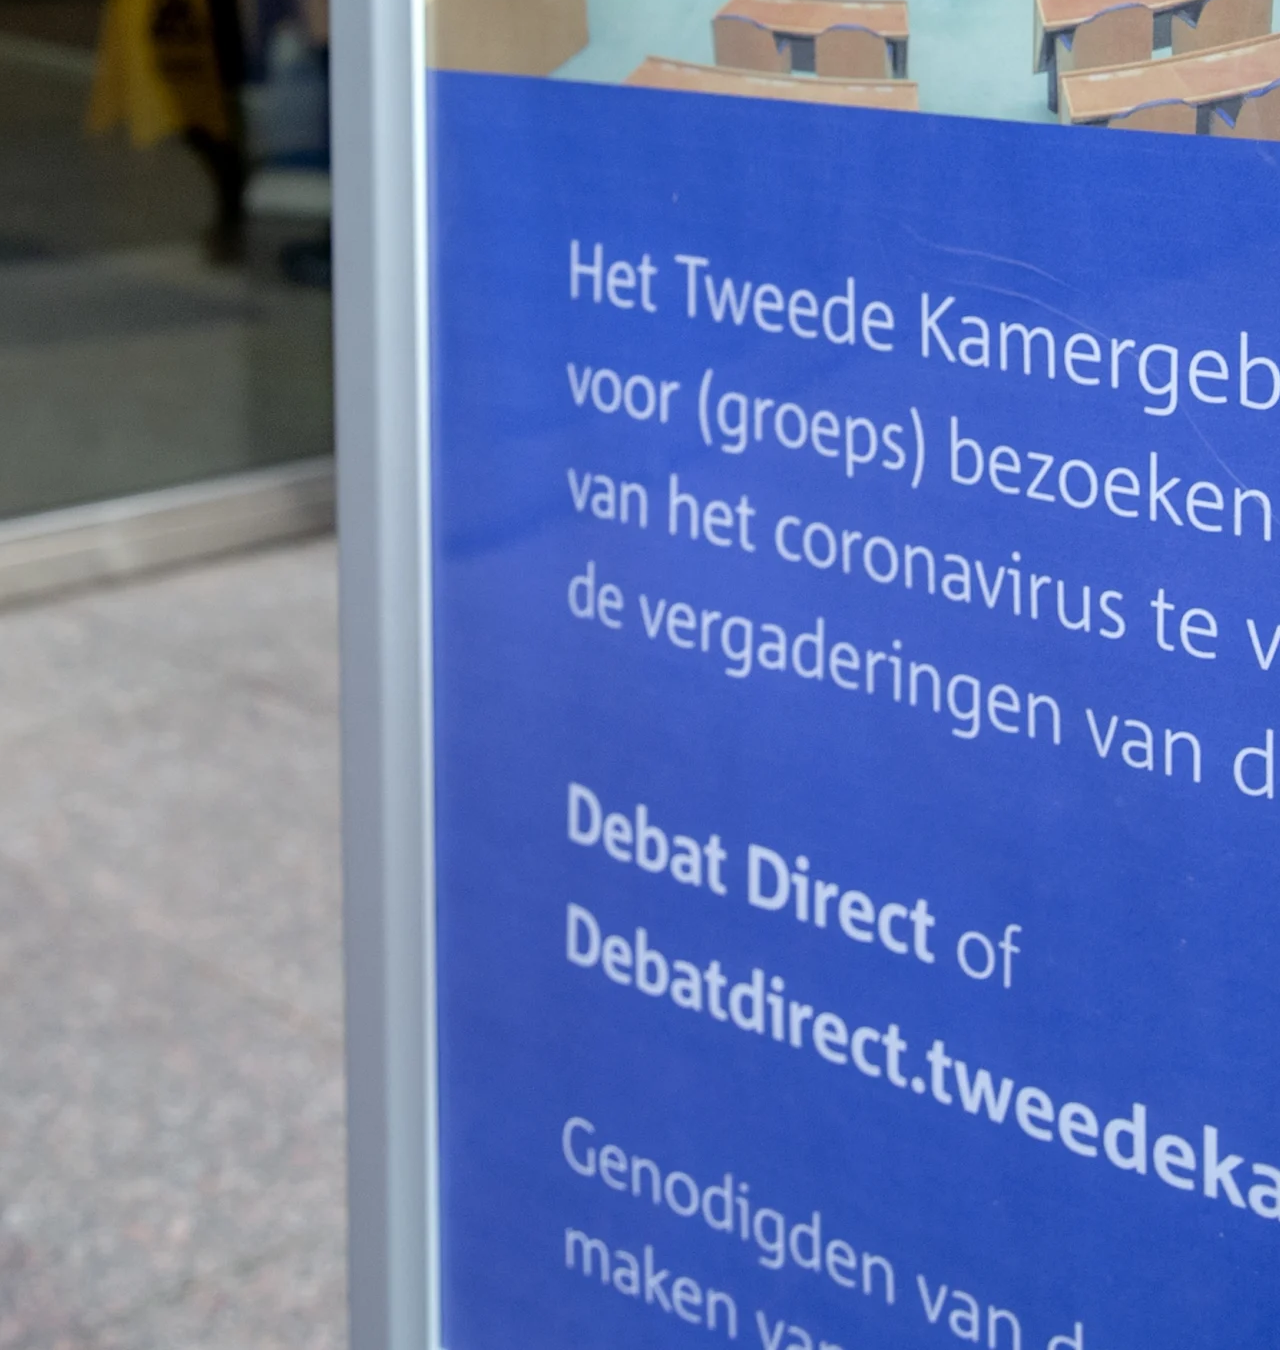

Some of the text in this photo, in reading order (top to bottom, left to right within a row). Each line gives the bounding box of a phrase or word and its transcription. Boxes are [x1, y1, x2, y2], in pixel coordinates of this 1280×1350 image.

[569, 239, 658, 313] Het
[674, 253, 895, 352] Tweede
[567, 363, 681, 424] voor
[698, 368, 925, 489] (groeps)
[950, 415, 1273, 542] bezoeken
[567, 468, 648, 528] van
[668, 473, 756, 552] het
[774, 515, 1126, 640] coronavirus
[1150, 588, 1219, 660] te
[568, 561, 624, 629] de
[639, 595, 1061, 745] vergaderingen
[1085, 708, 1202, 783] van
[567, 782, 1022, 989] Debat Direct of
[562, 1116, 1022, 1350] Genodigden van
[565, 1228, 843, 1350] maken va
